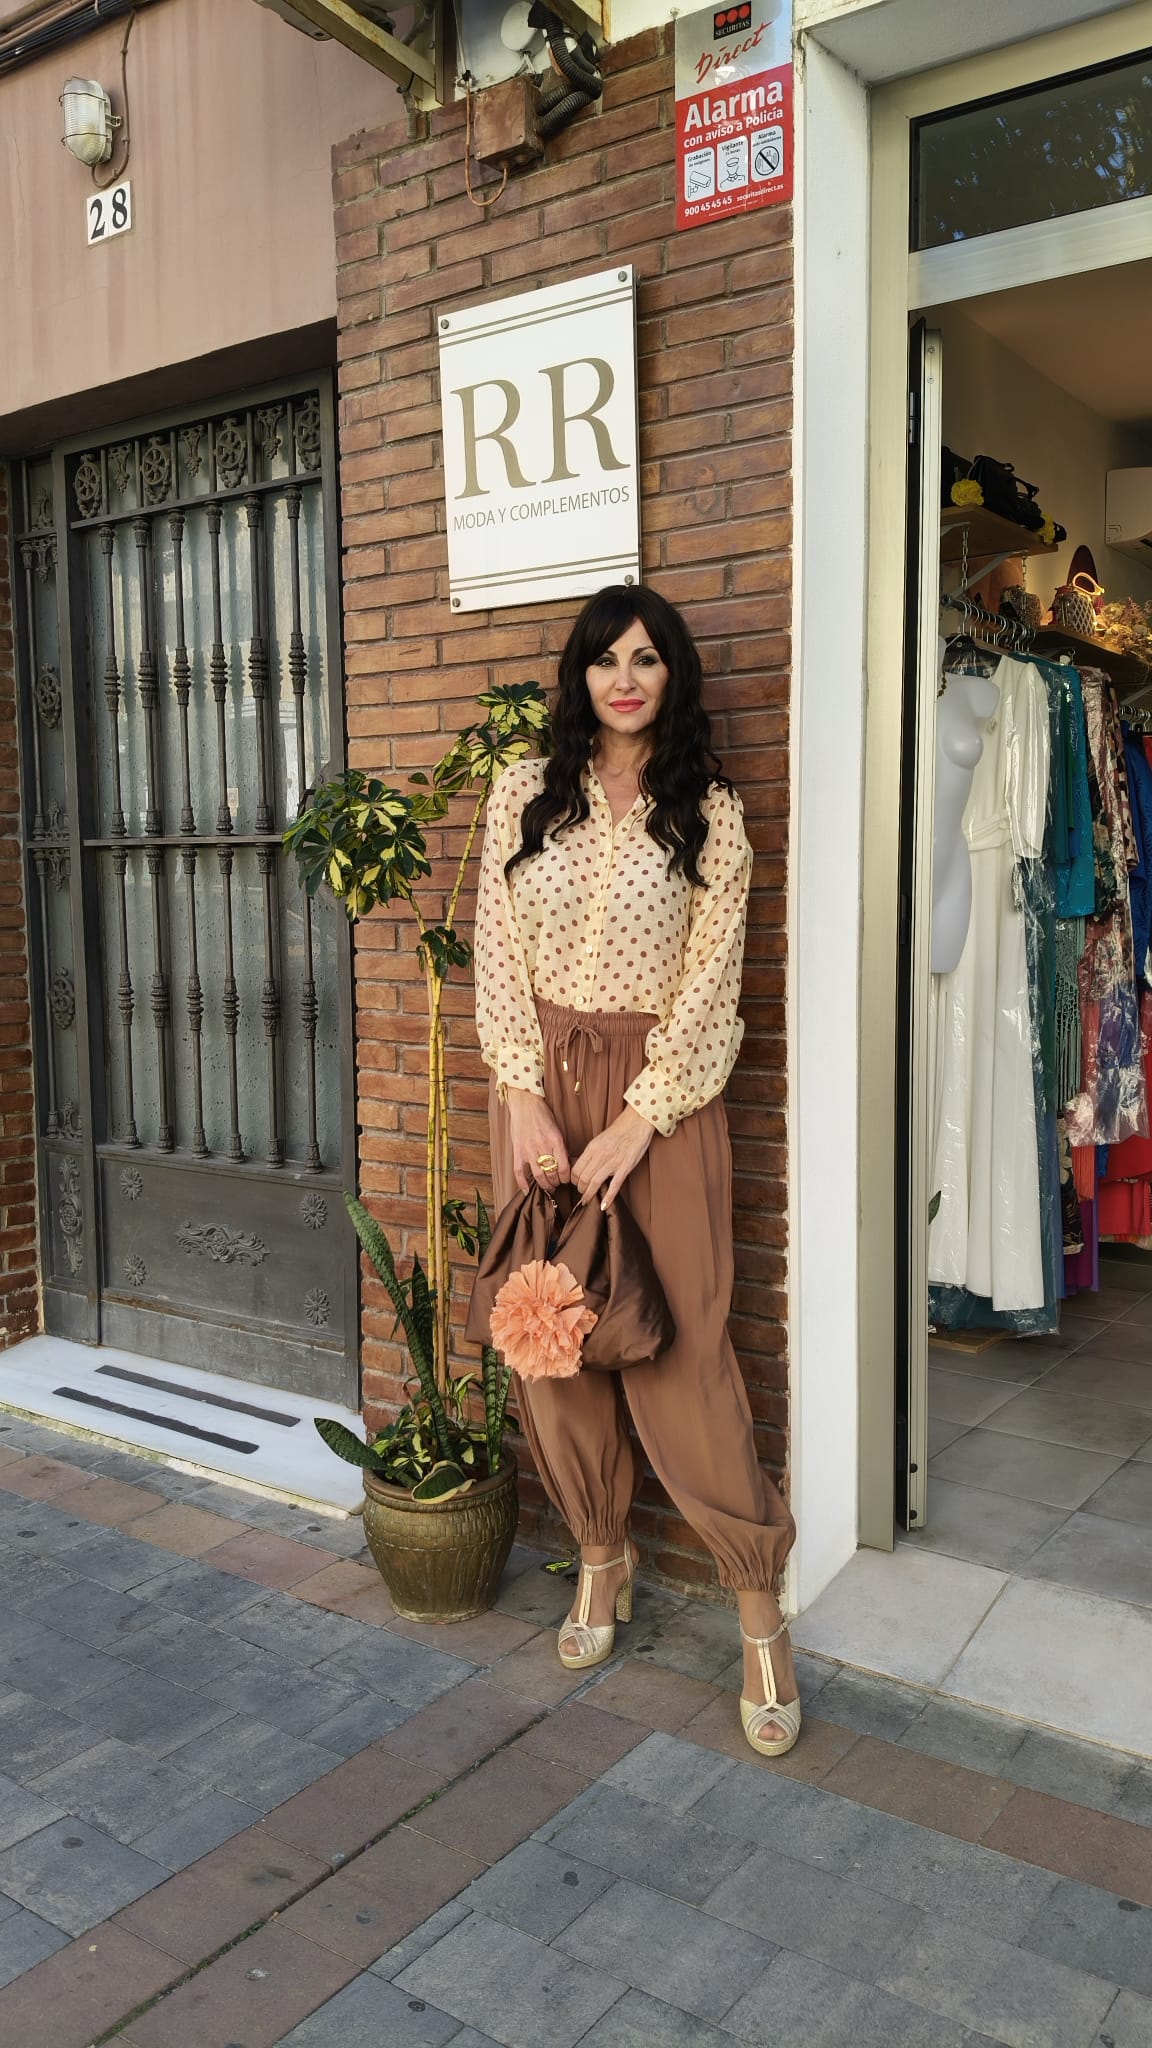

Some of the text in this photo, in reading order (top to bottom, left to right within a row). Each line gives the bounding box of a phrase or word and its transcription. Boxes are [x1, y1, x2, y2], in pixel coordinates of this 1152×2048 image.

[715, 20, 751, 36] SECURITAS
[694, 20, 774, 84] Direct
[684, 81, 783, 132] Alarma
[684, 107, 784, 148] con aviso a Policía
[89, 188, 128, 240] 28
[684, 205, 700, 217] 900
[700, 201, 711, 212] 45
[711, 198, 722, 209] 45
[722, 195, 733, 206] 45
[453, 485, 630, 532] MODA Y COMPLEMENTOS
